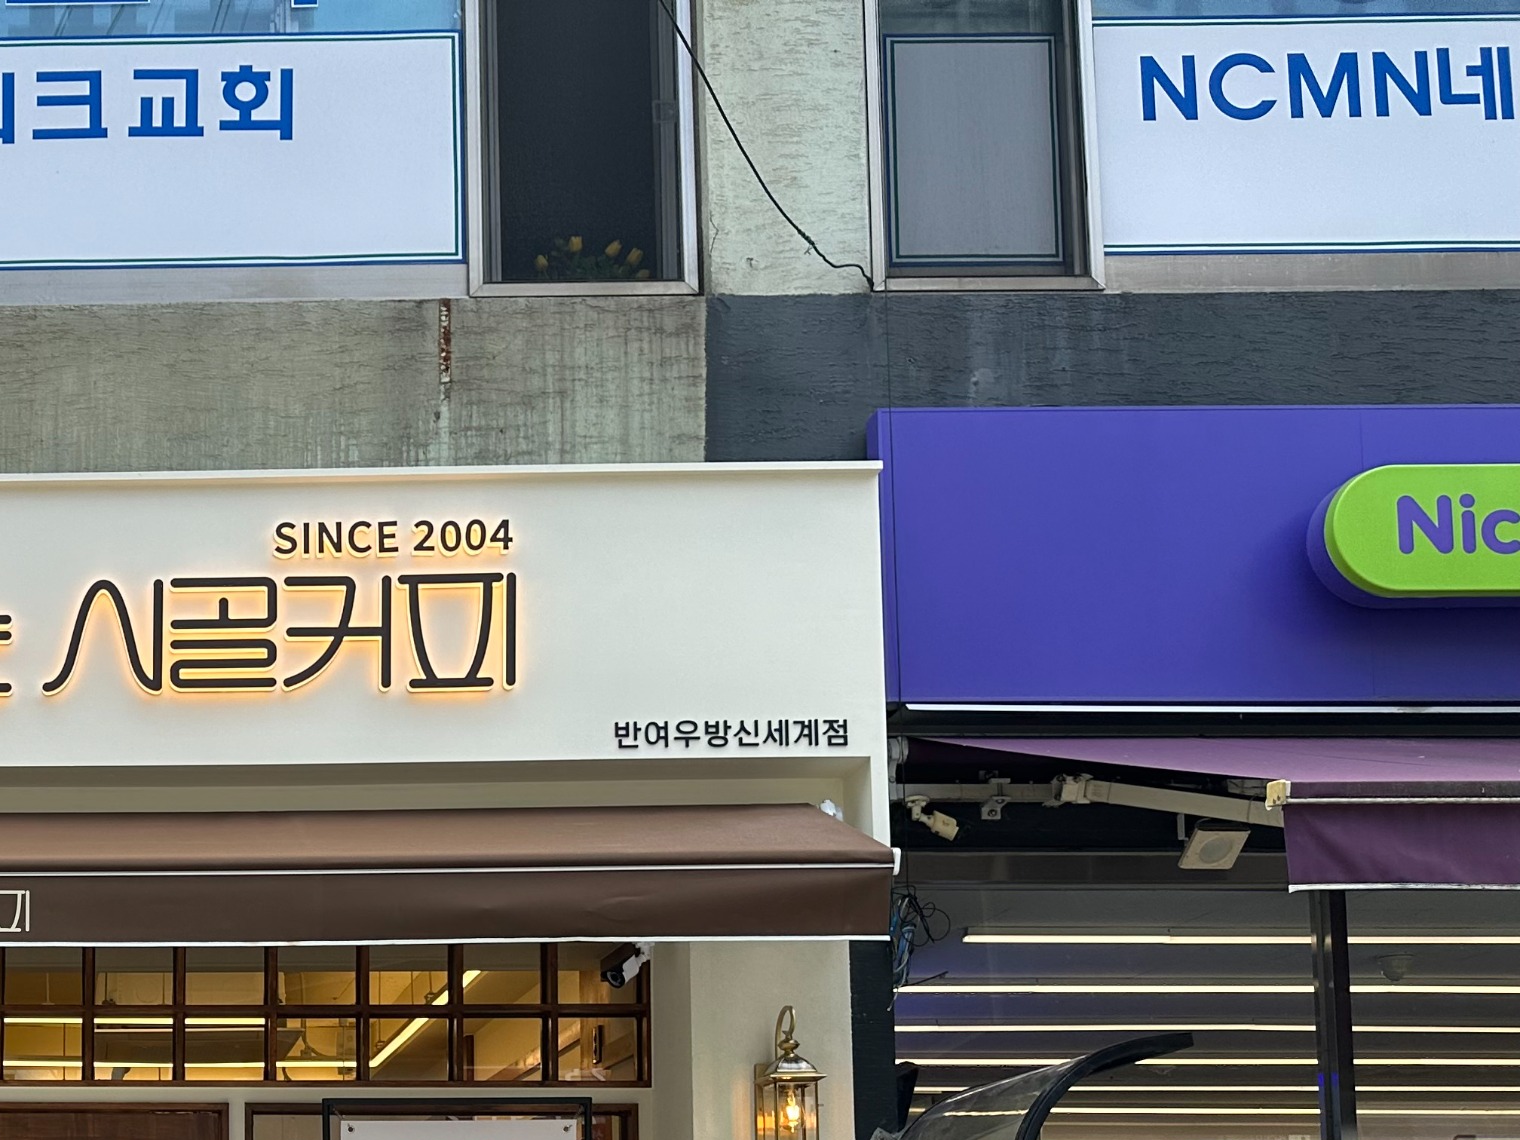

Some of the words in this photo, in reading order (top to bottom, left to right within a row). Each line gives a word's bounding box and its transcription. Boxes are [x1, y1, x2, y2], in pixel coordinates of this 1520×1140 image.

[1139, 46, 1514, 122] NCMN네
[275, 520, 399, 555] SINCE
[412, 518, 514, 553] 2004
[41, 571, 517, 695] 시골커피
[614, 719, 849, 750] 반여우방신세계점
